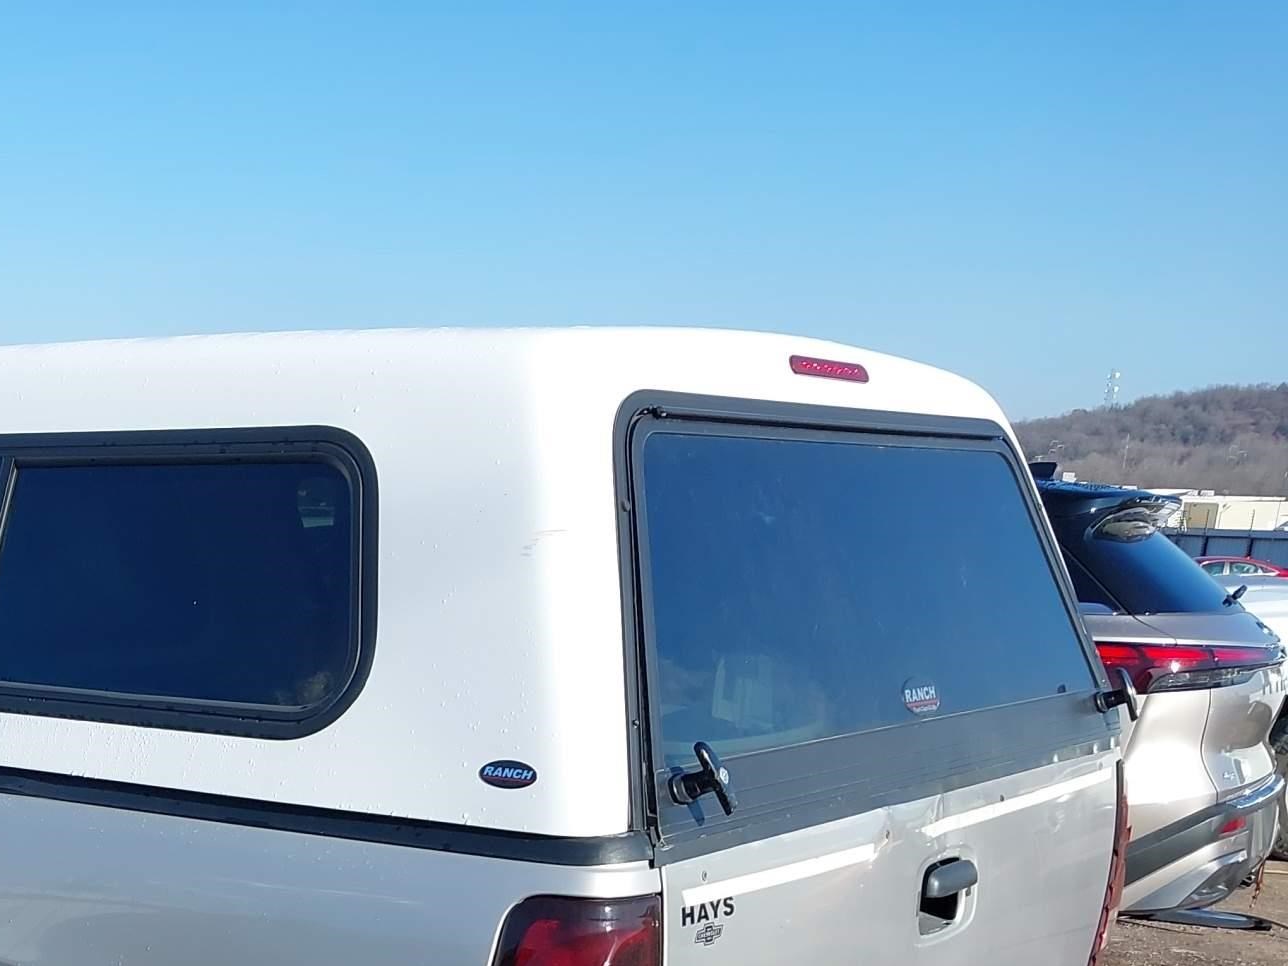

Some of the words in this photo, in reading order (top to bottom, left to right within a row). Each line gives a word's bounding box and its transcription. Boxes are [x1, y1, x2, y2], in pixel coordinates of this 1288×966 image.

[904, 685, 936, 703] RANCH
[483, 766, 534, 780] RANCH
[681, 896, 734, 927] HAYS
